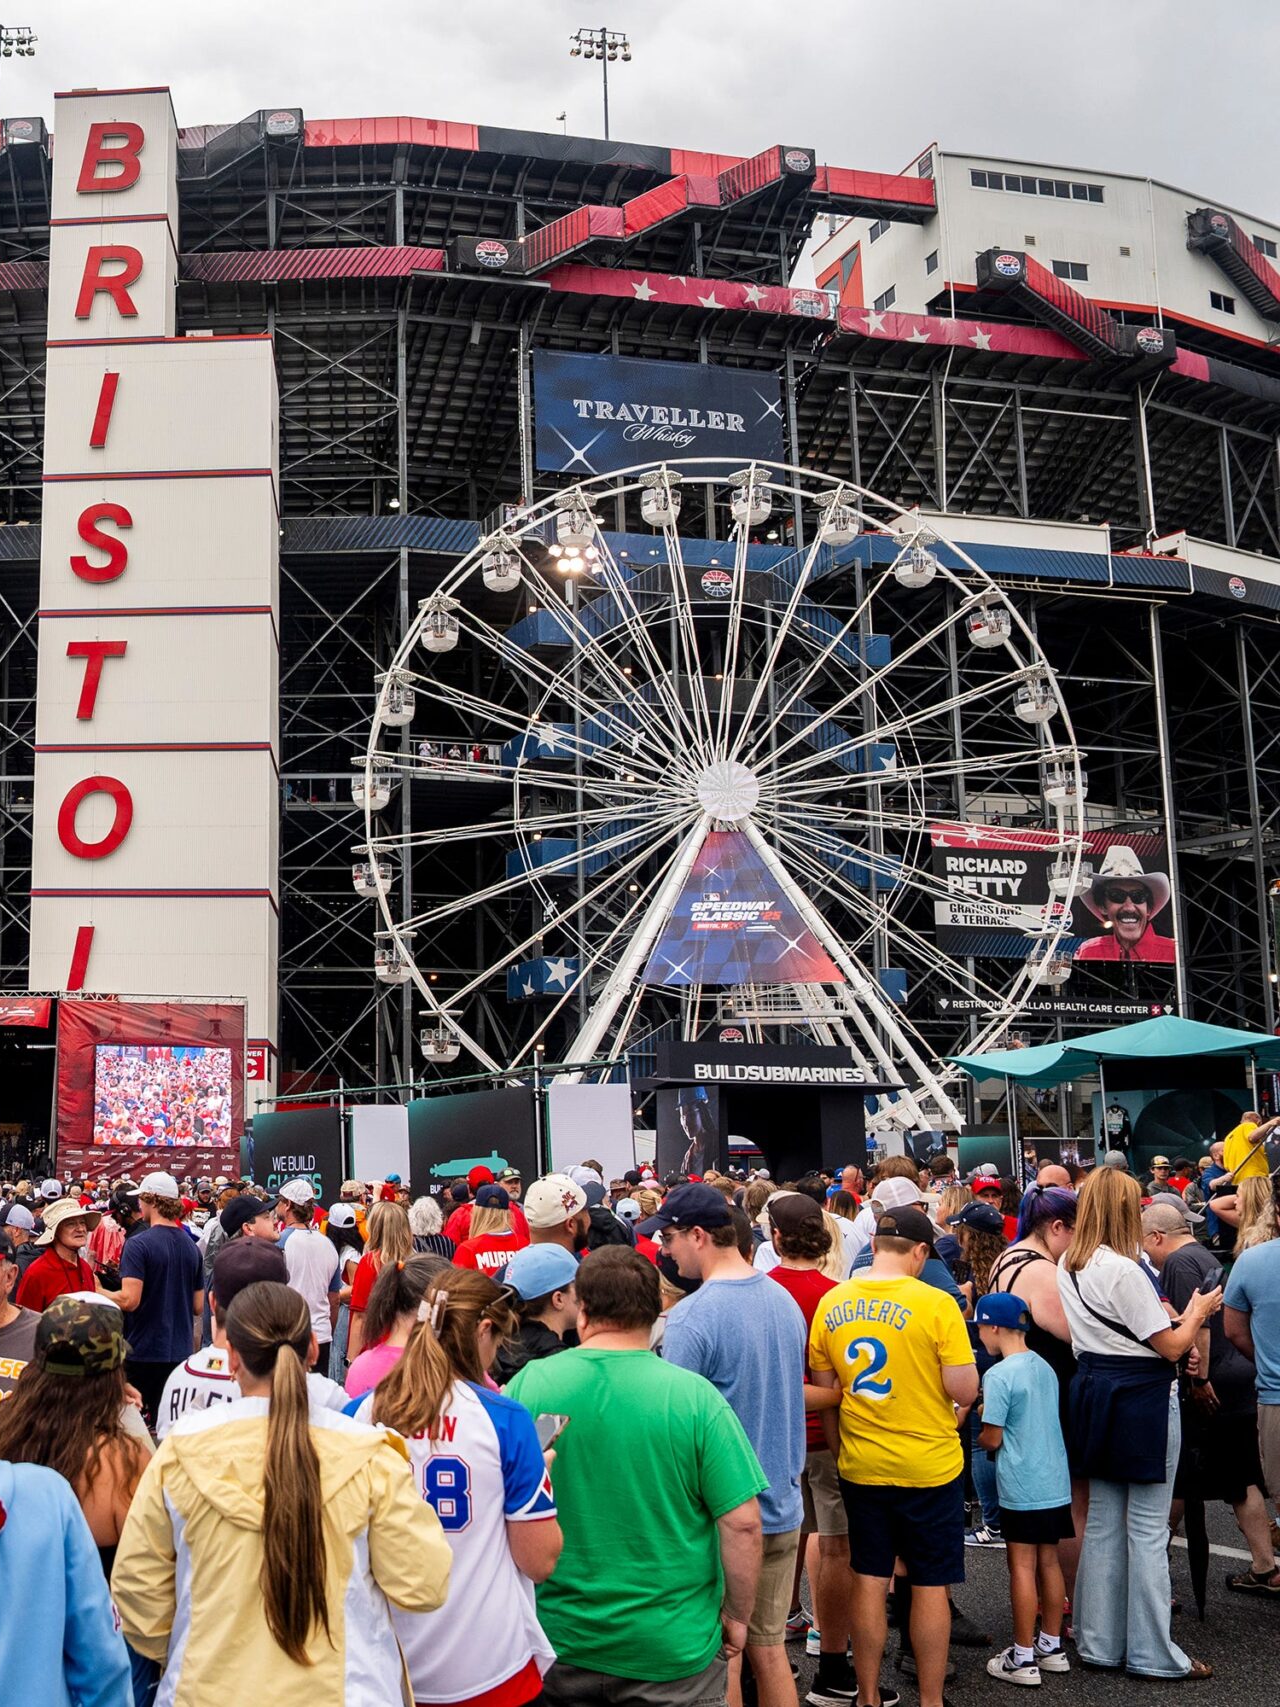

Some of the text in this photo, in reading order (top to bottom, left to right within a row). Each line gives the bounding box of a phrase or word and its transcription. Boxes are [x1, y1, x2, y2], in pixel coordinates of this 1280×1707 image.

[572, 398, 747, 433] TRAVELLER
[622, 423, 697, 449] Whiskey
[945, 856, 1028, 875] RICHARD
[947, 875, 1023, 898] PETTY
[690, 901, 776, 912] SPEEDWAY
[690, 911, 761, 922] CLASSIC
[950, 914, 961, 925] &
[1053, 1002, 1087, 1012] HEALTH
[1089, 1004, 1112, 1013] CARE
[1113, 1004, 1149, 1015] CENTER
[693, 1063, 866, 1084] BUILDSUBMARINES
[271, 1154, 316, 1172] WE BUILD
[267, 1172, 323, 1200] GIS
[475, 1249, 521, 1271] MURP
[823, 1298, 913, 1335] BOGAERTS
[844, 1336, 892, 1401] 2
